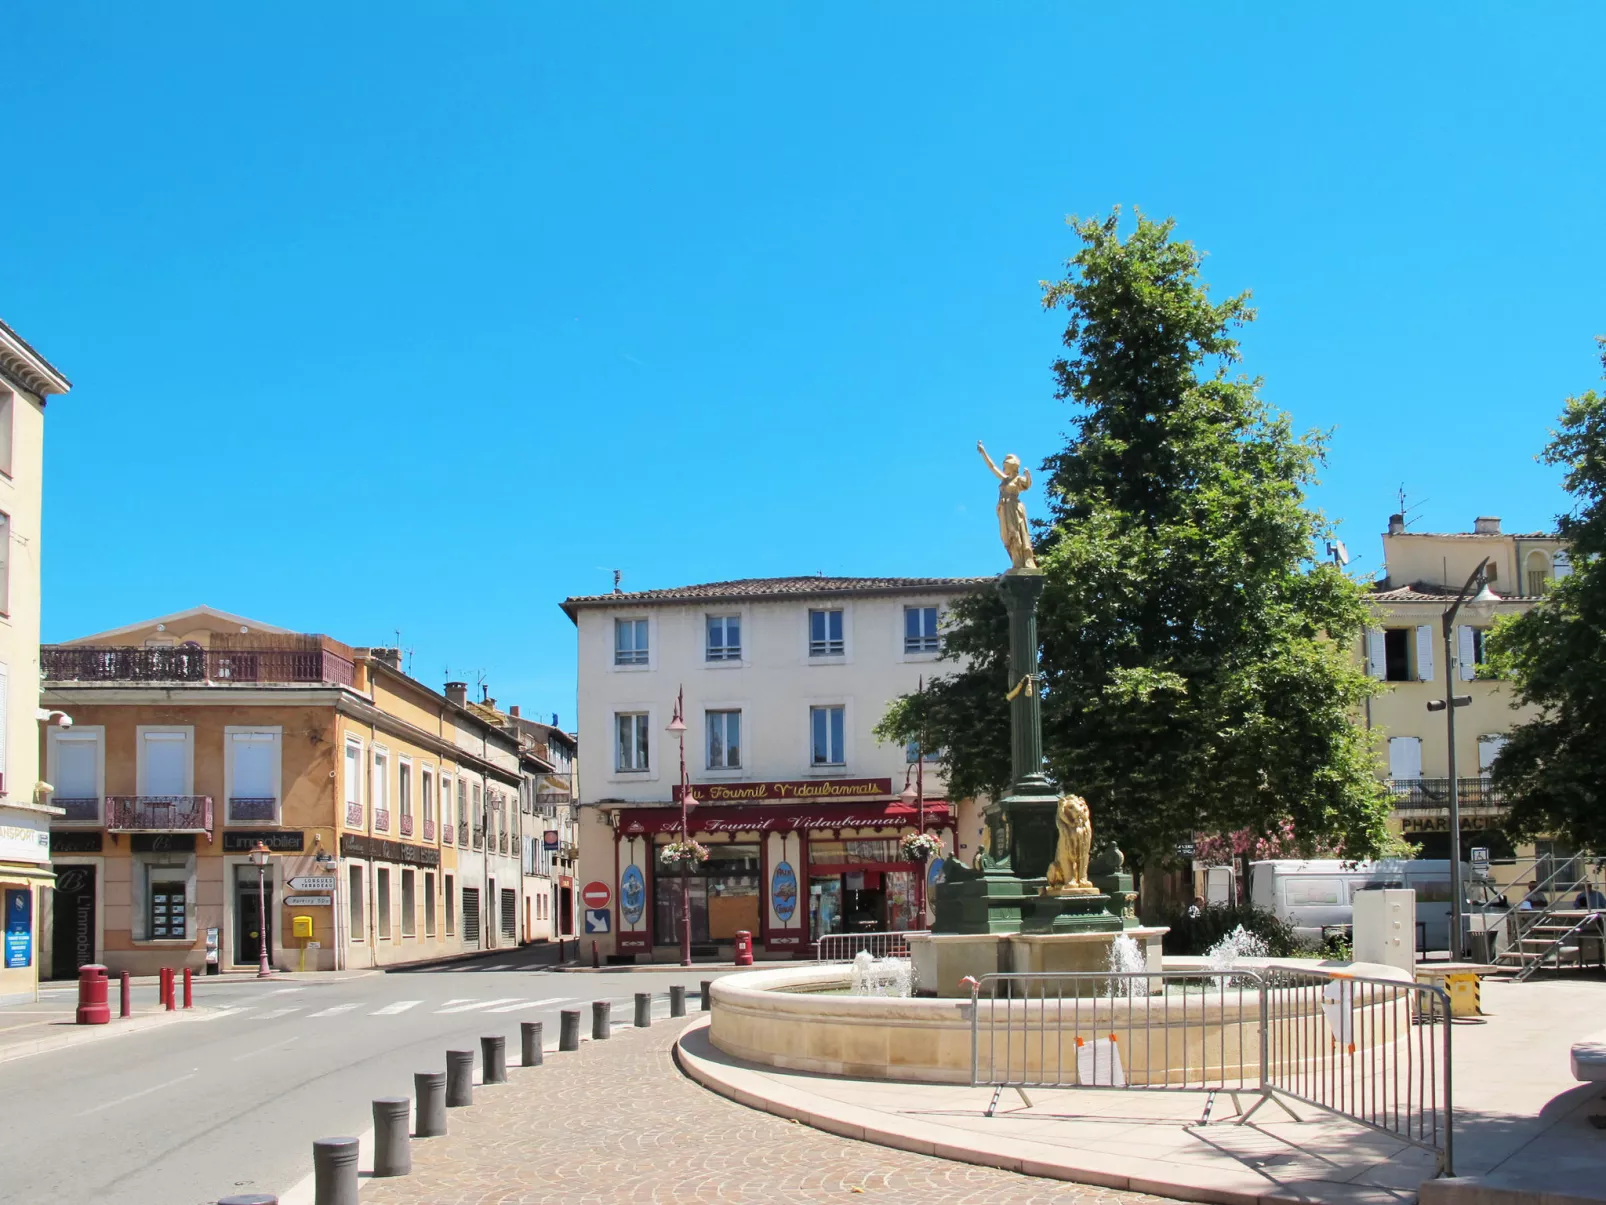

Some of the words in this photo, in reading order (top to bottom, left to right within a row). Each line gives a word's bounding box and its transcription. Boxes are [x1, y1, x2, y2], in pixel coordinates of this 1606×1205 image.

[710, 784, 768, 799] Fournil
[774, 782, 883, 797] Vidaubannais
[704, 818, 775, 831] Fournil
[788, 815, 908, 828] Vidaubannais
[1402, 817, 1499, 832] PHARACI
[77, 895, 91, 968] L'Immobilie
